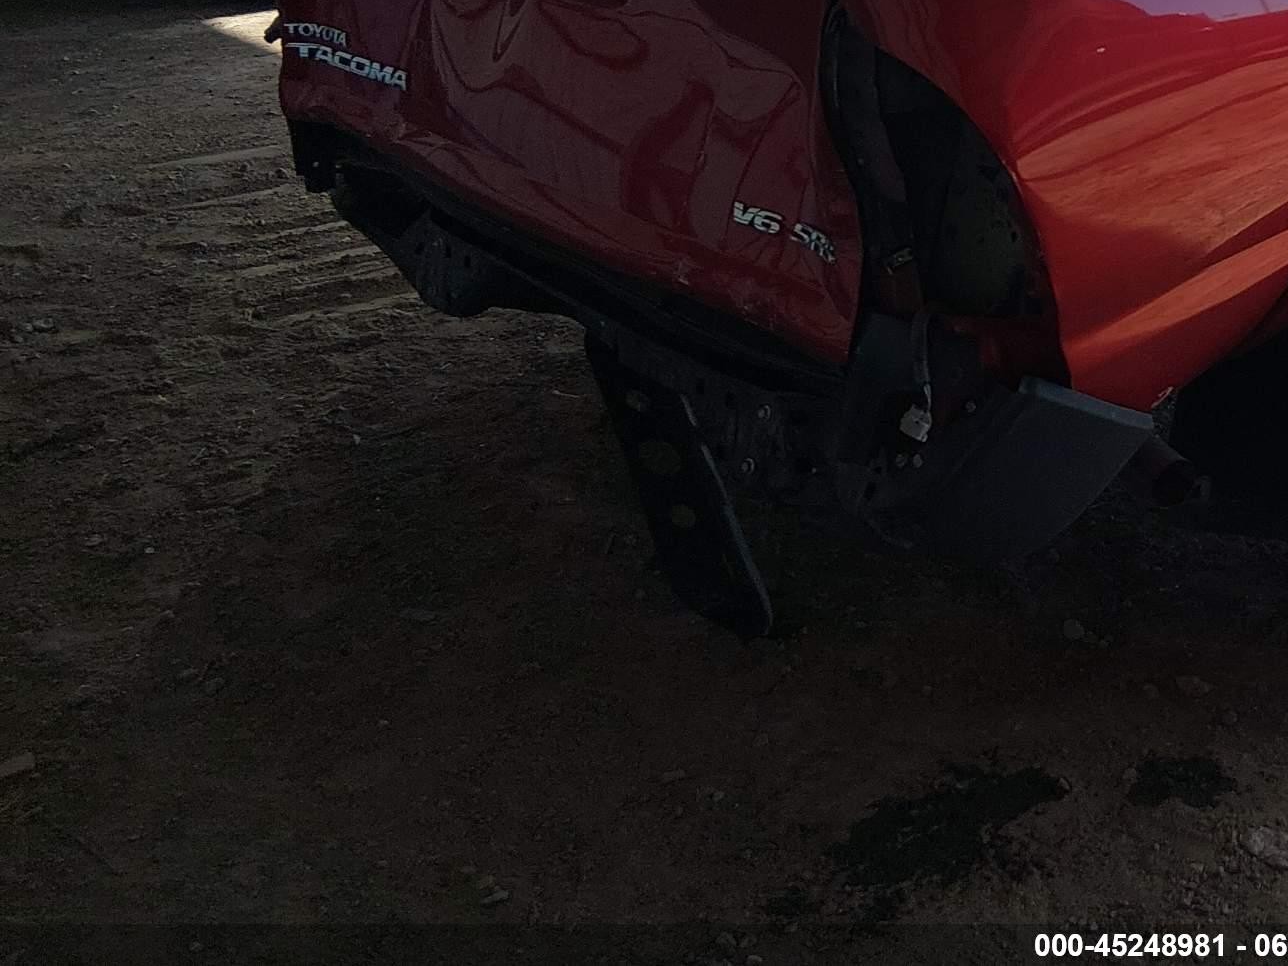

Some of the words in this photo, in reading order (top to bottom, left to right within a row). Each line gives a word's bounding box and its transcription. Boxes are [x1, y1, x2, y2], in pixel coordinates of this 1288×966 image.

[284, 22, 348, 49] TOYOTA
[285, 41, 408, 91] TACOMA
[732, 200, 784, 234] V6
